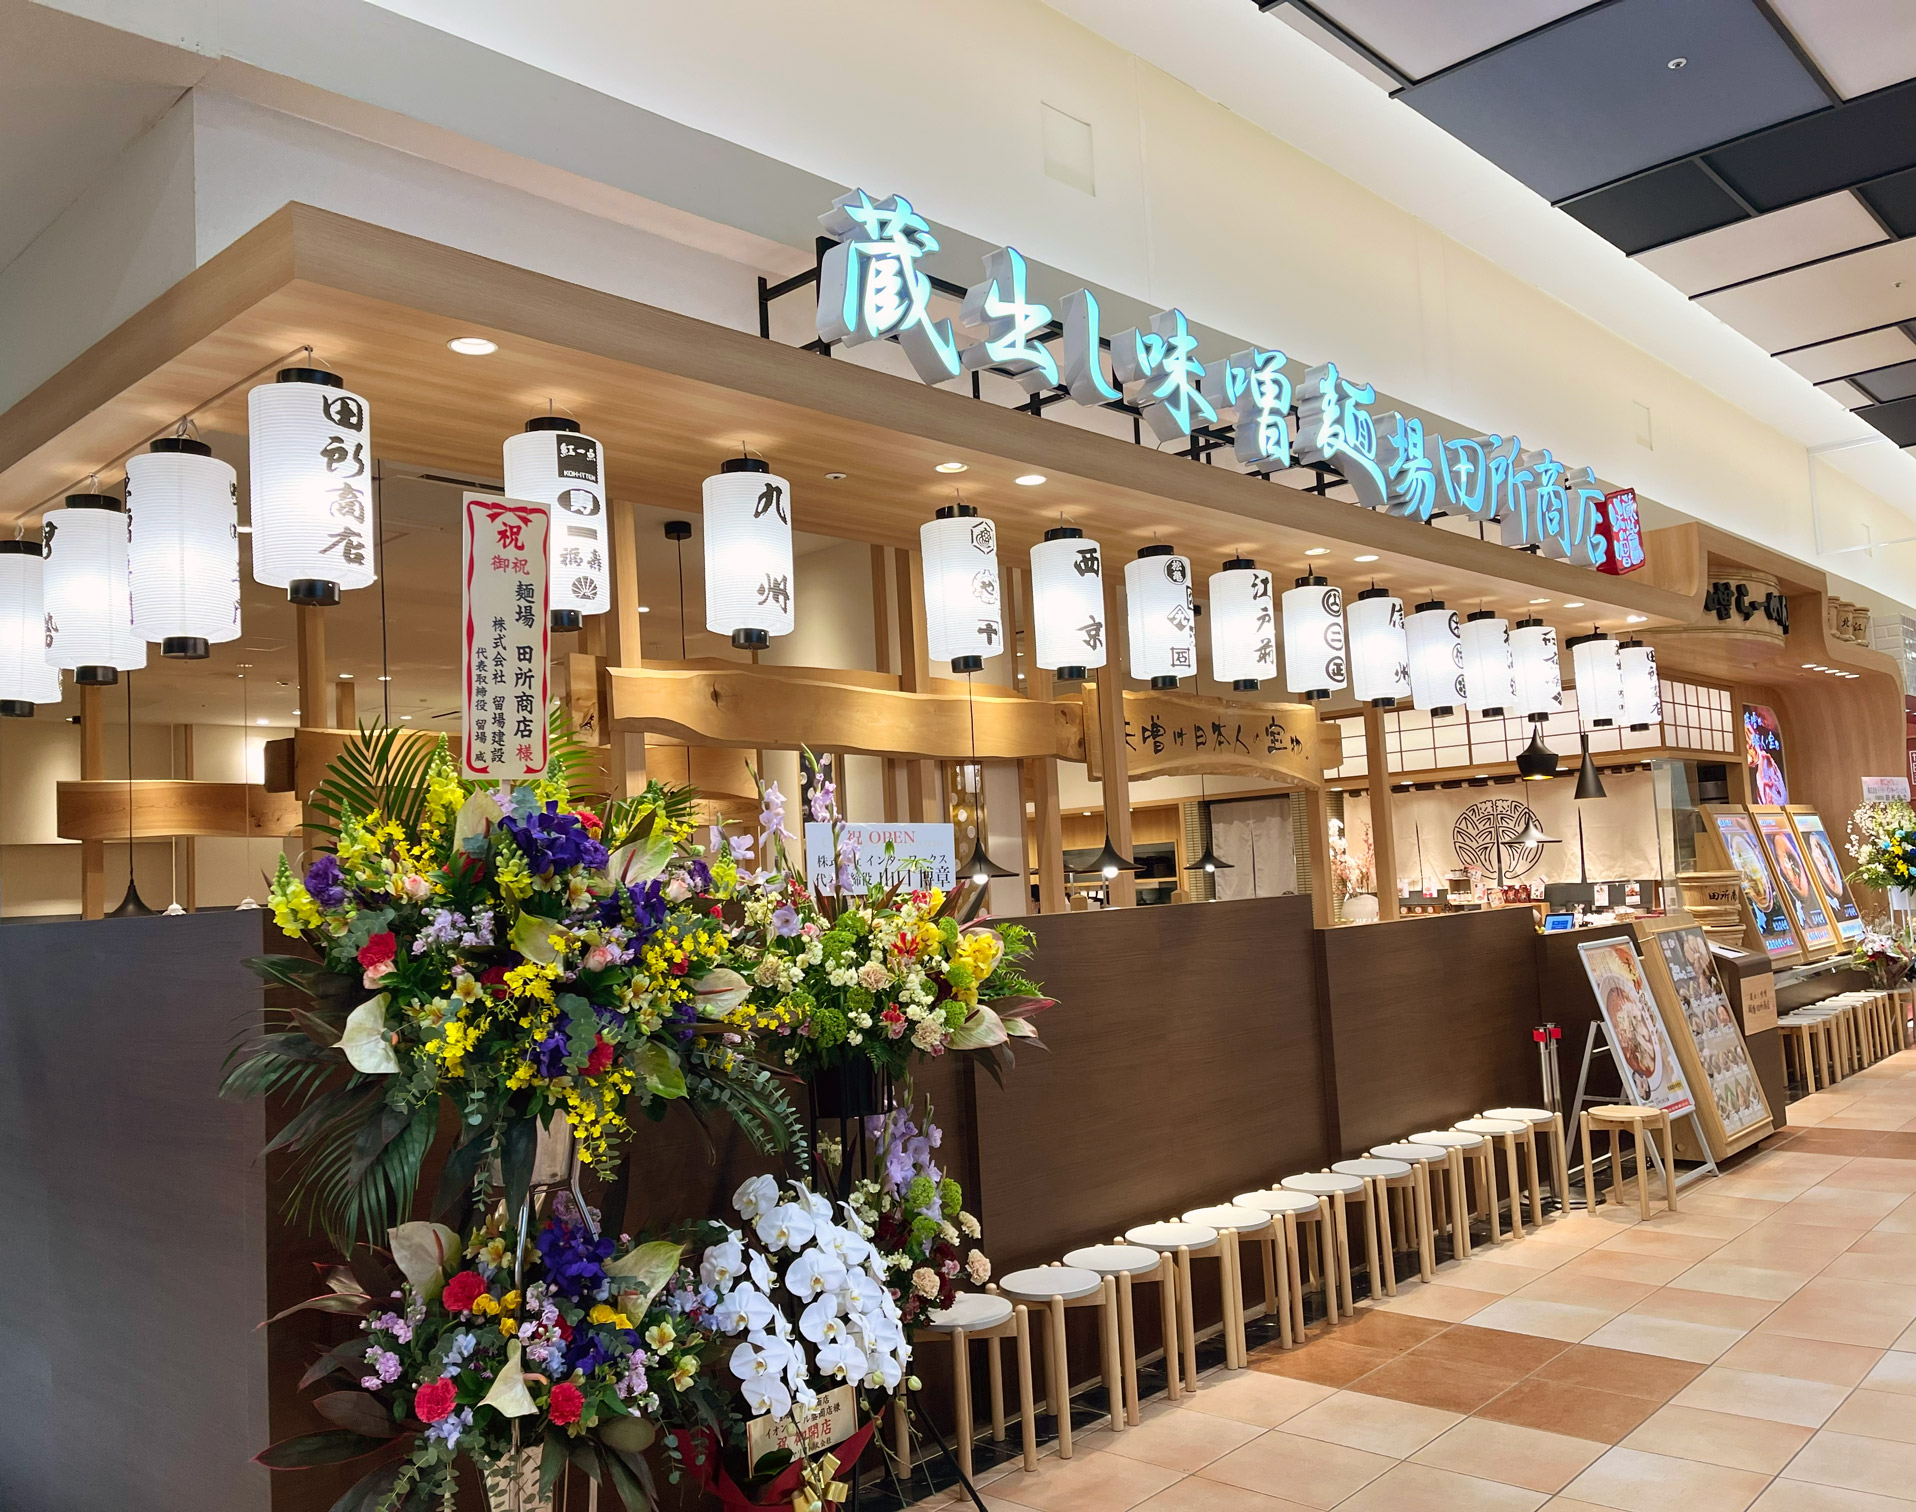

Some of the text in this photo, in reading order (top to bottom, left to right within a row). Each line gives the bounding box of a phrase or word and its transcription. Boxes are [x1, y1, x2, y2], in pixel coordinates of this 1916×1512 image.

[319, 394, 366, 566] 田所商店
[559, 442, 597, 462] 紅一点
[490, 554, 530, 576] 御祝
[496, 521, 526, 551] 祝
[753, 482, 791, 615] 九州
[1073, 547, 1103, 651] 西京
[1250, 573, 1275, 665] 江戸前
[474, 646, 489, 712] 代表取締役
[490, 616, 508, 764] 株式会社 留場建設
[513, 580, 536, 762] 麺場 田所商店 様
[474, 718, 488, 744] 留場
[868, 830, 916, 845] OPEN
